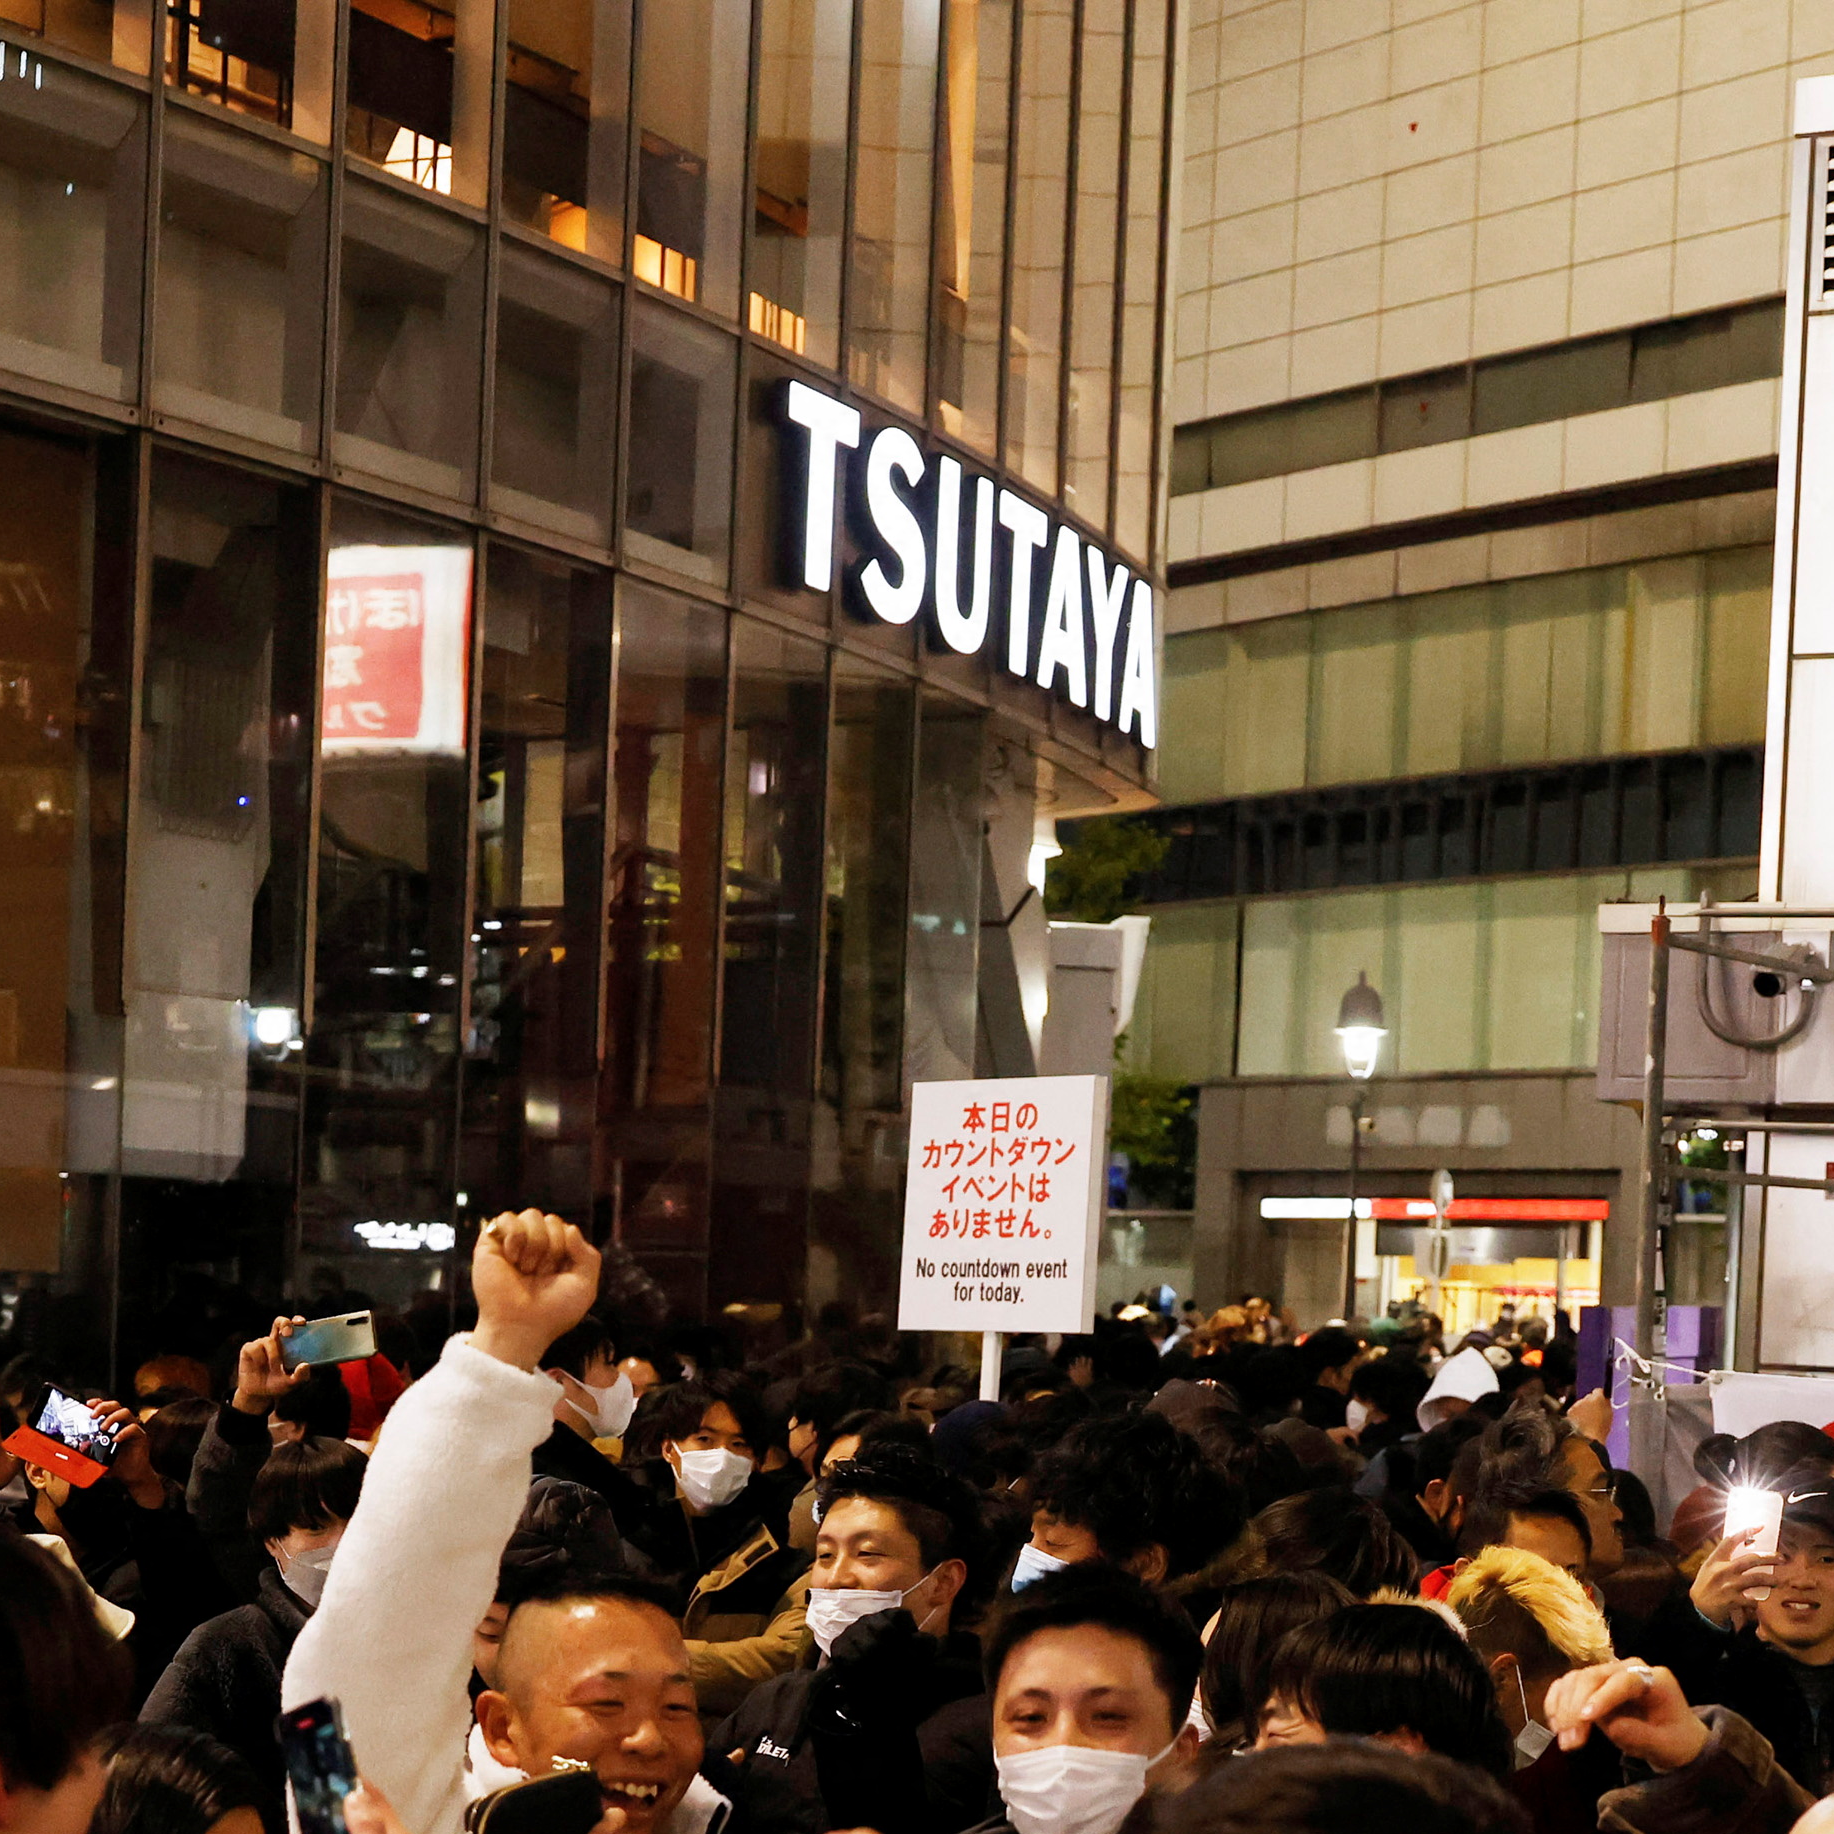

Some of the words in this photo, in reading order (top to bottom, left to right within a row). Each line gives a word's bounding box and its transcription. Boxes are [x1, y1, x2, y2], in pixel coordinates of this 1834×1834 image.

[787, 379, 1157, 750] TSUTAYA
[962, 1101, 1039, 1133] 本日の
[922, 1136, 1076, 1169] カウントダウン
[941, 1172, 1051, 1203] イベントは
[928, 1208, 1052, 1239] ありません。
[916, 1257, 935, 1278] No
[941, 1258, 1020, 1279] countdown
[1026, 1258, 1068, 1279] event
[954, 1281, 975, 1302] for
[980, 1282, 1025, 1305] today.
